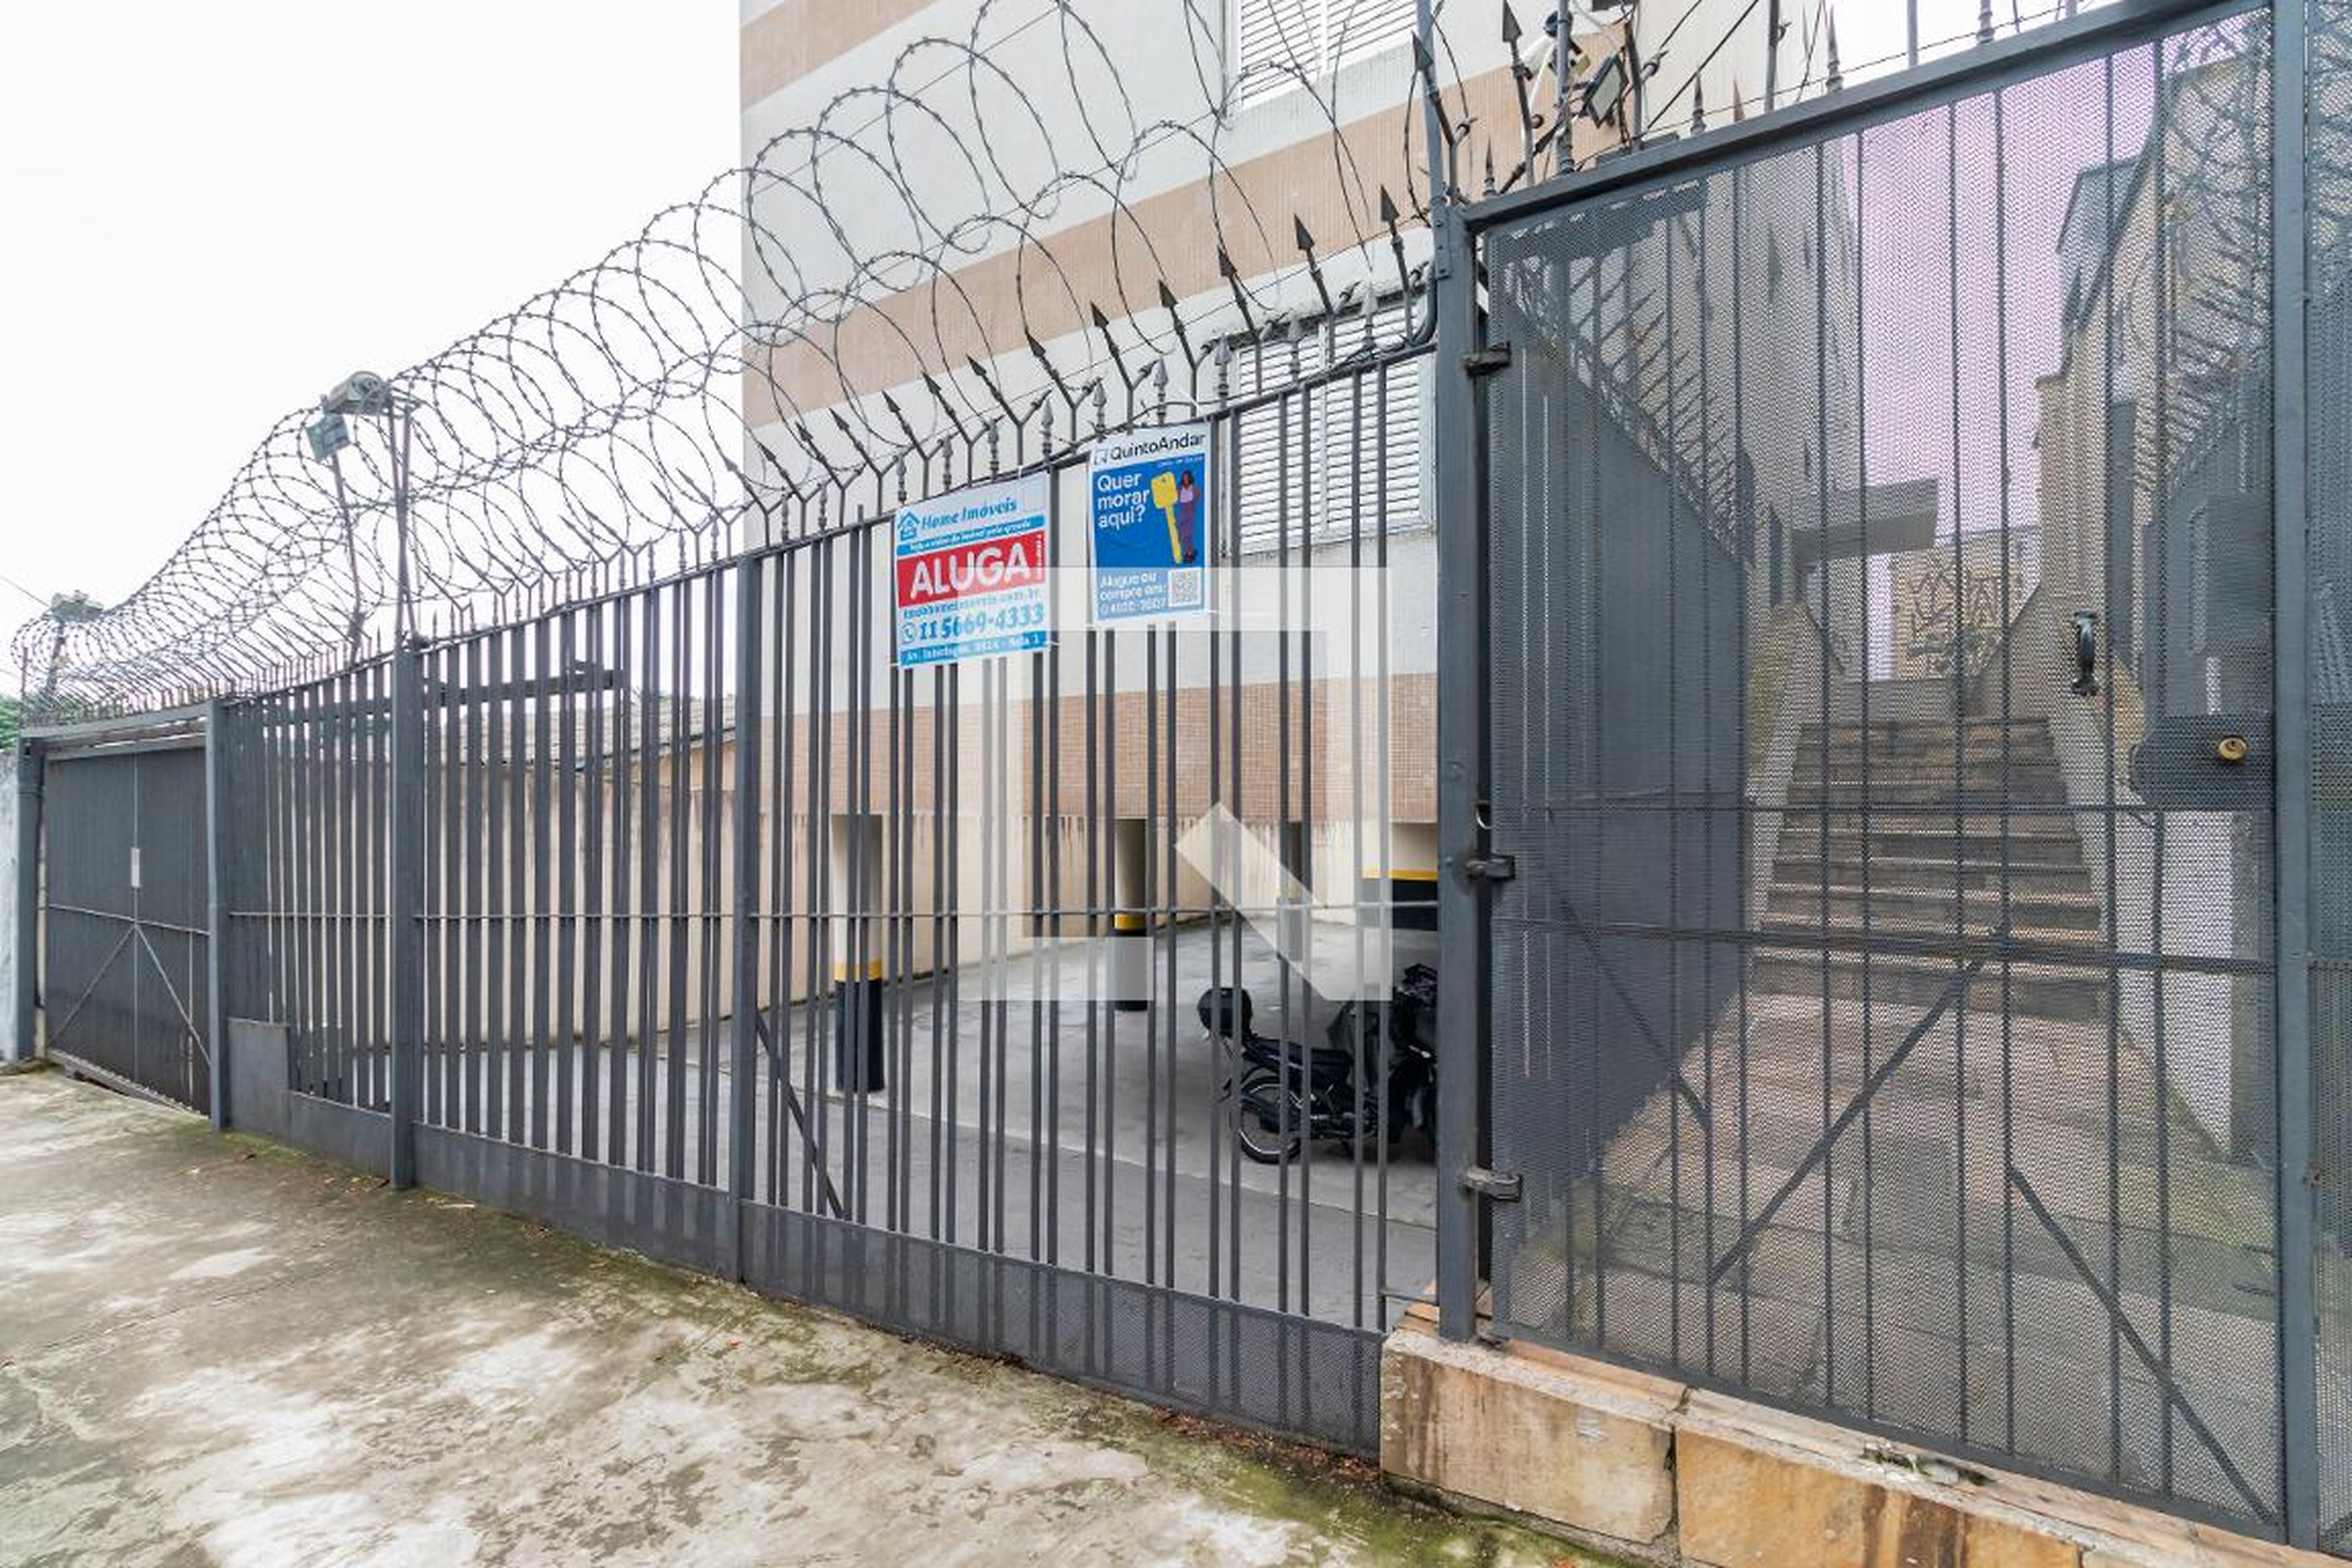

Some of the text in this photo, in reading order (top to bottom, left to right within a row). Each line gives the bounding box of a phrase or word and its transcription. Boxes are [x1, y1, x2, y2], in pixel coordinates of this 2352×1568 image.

[1110, 433, 1205, 460] QuintoAndar
[1098, 473, 1142, 492] Quer
[1098, 489, 1150, 510] morar
[921, 497, 1017, 529] Home Imóveis
[1098, 505, 1145, 530] aqui?
[910, 543, 1031, 600] ALUGA
